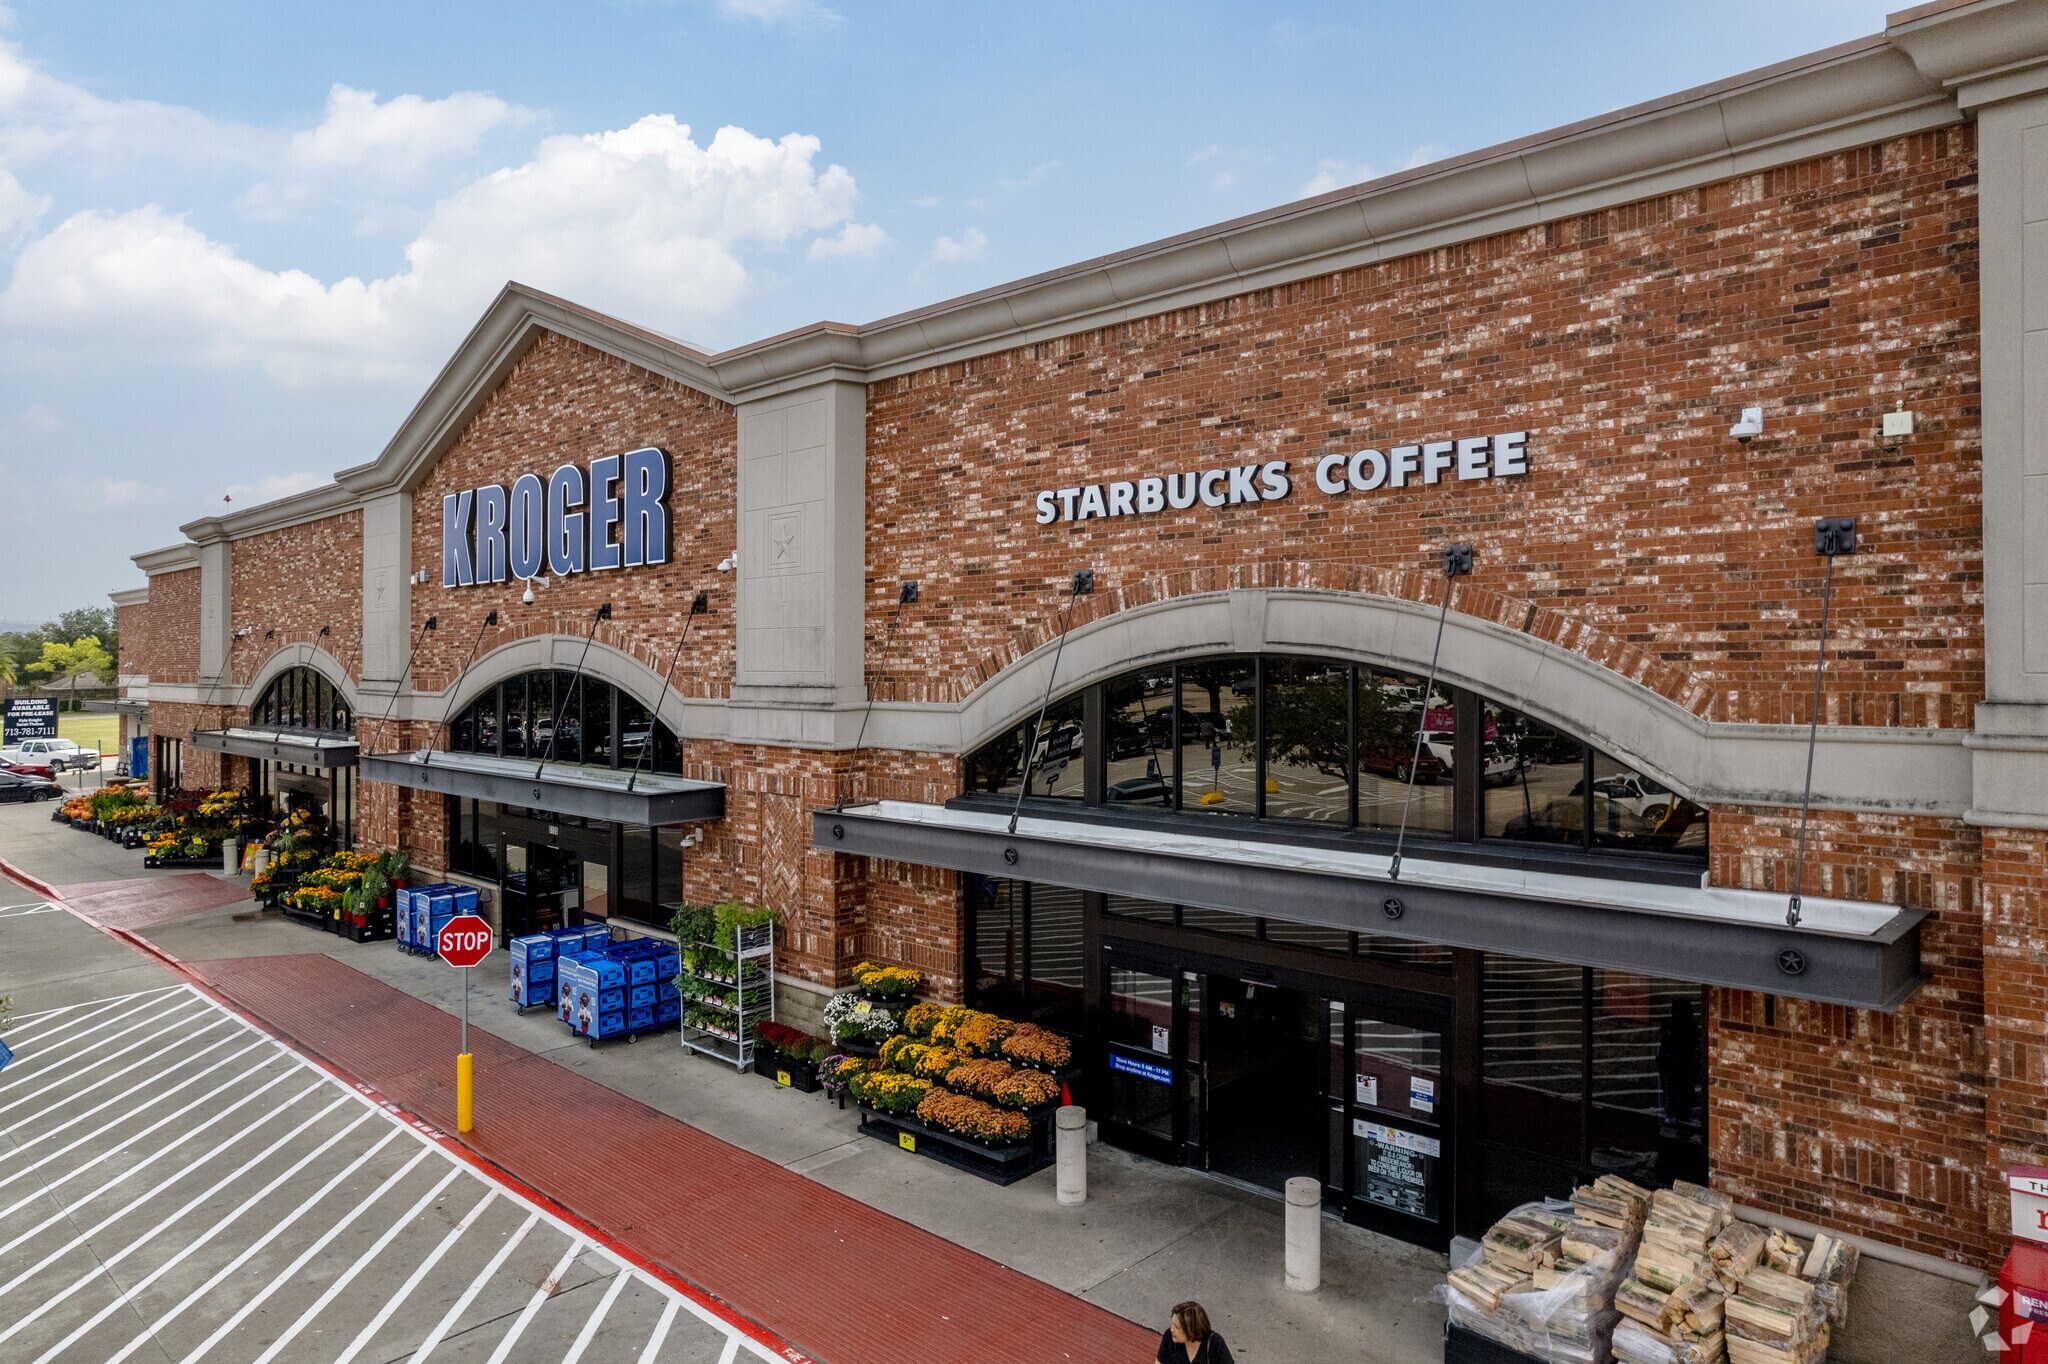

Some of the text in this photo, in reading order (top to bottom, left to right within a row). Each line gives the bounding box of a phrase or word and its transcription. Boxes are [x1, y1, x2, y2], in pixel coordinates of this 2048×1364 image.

[1035, 430, 1530, 525] STARBUCKS COFFEE
[443, 447, 671, 588] KROGER
[4, 727, 55, 736] 713-781-7111
[442, 931, 489, 952] STOP
[1115, 1062, 1126, 1071] Shop
[1116, 1056, 1127, 1064] Store
